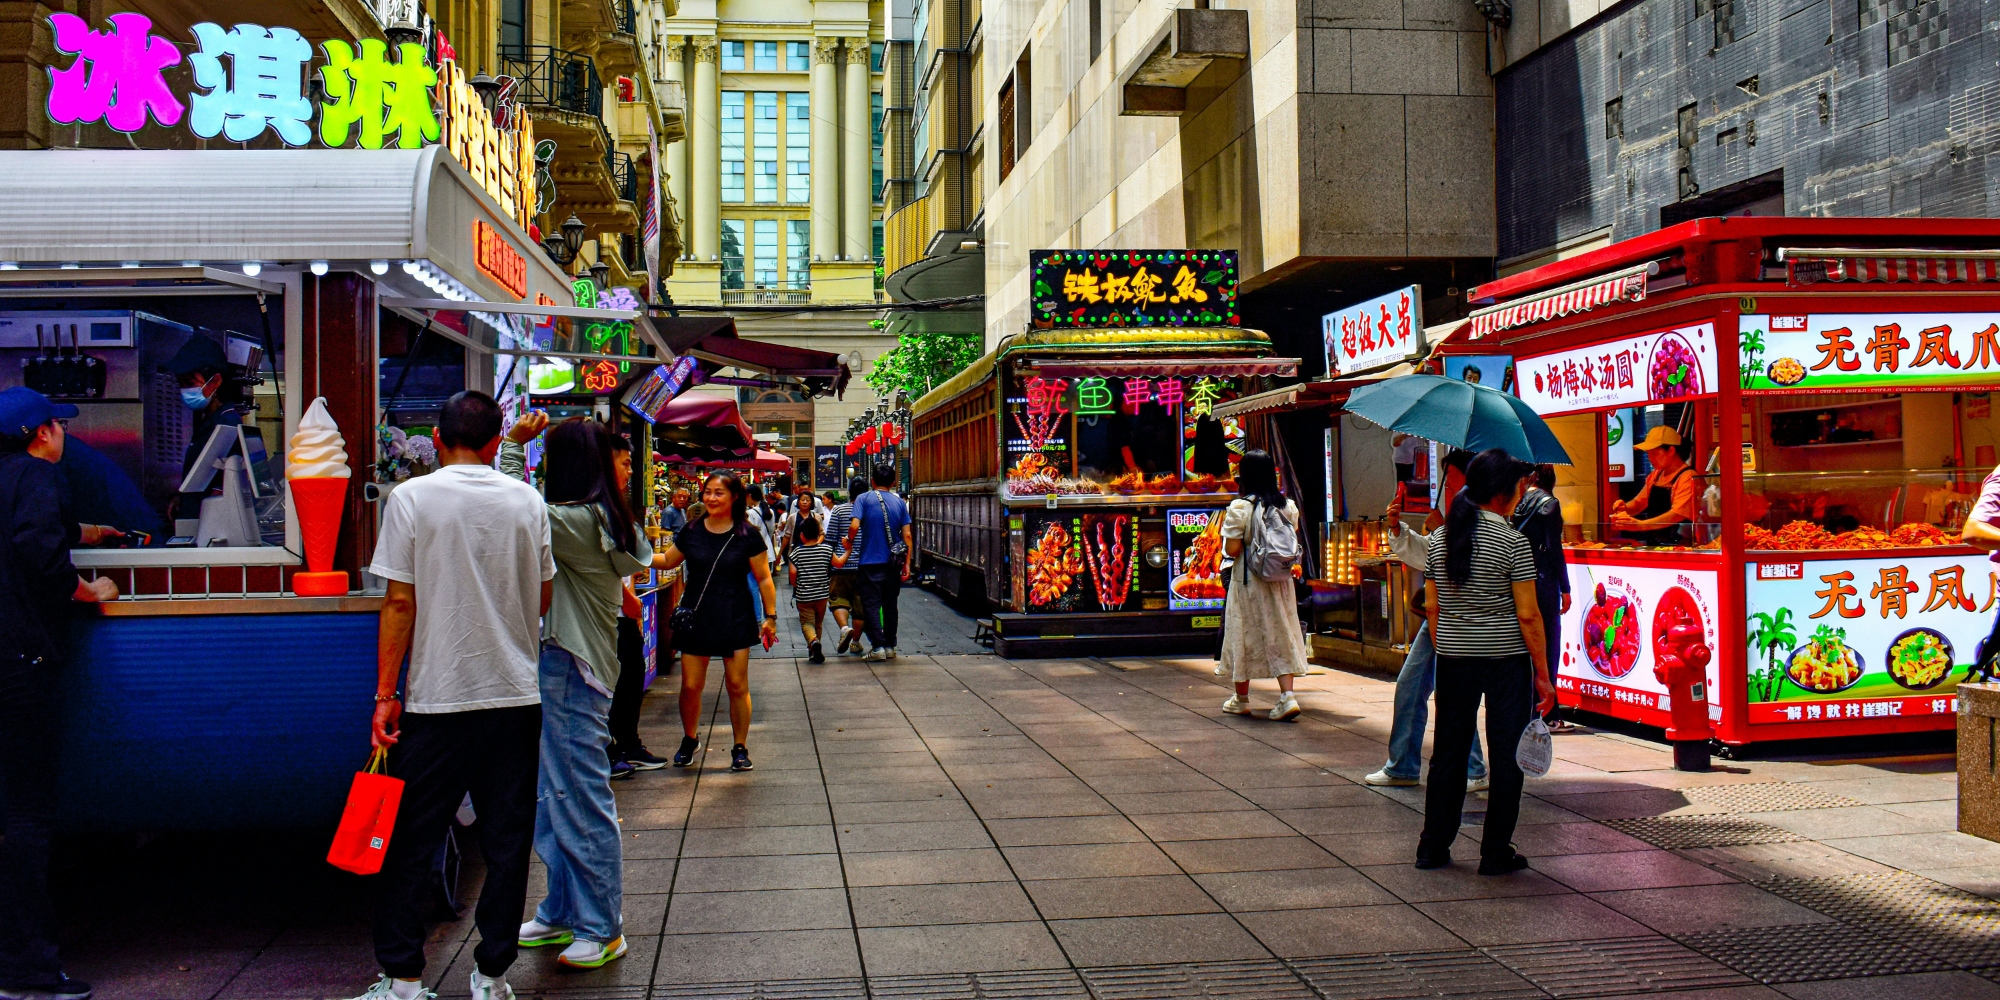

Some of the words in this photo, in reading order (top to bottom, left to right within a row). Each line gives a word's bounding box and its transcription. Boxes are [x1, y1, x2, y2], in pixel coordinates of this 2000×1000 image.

[45, 11, 441, 149] 冰淇淋
[1063, 265, 1208, 311] 铁板鱿鱼
[1741, 299, 1754, 309] 01
[1341, 290, 1411, 359] 超级大串
[1810, 323, 2000, 373] 无骨凤爪
[1026, 376, 1222, 417] 鱿鱼串串香
[1546, 349, 1634, 399] 杨梅冰汤圆
[1171, 513, 1210, 527] 串串香
[1580, 682, 1610, 699] 吃了还想吃
